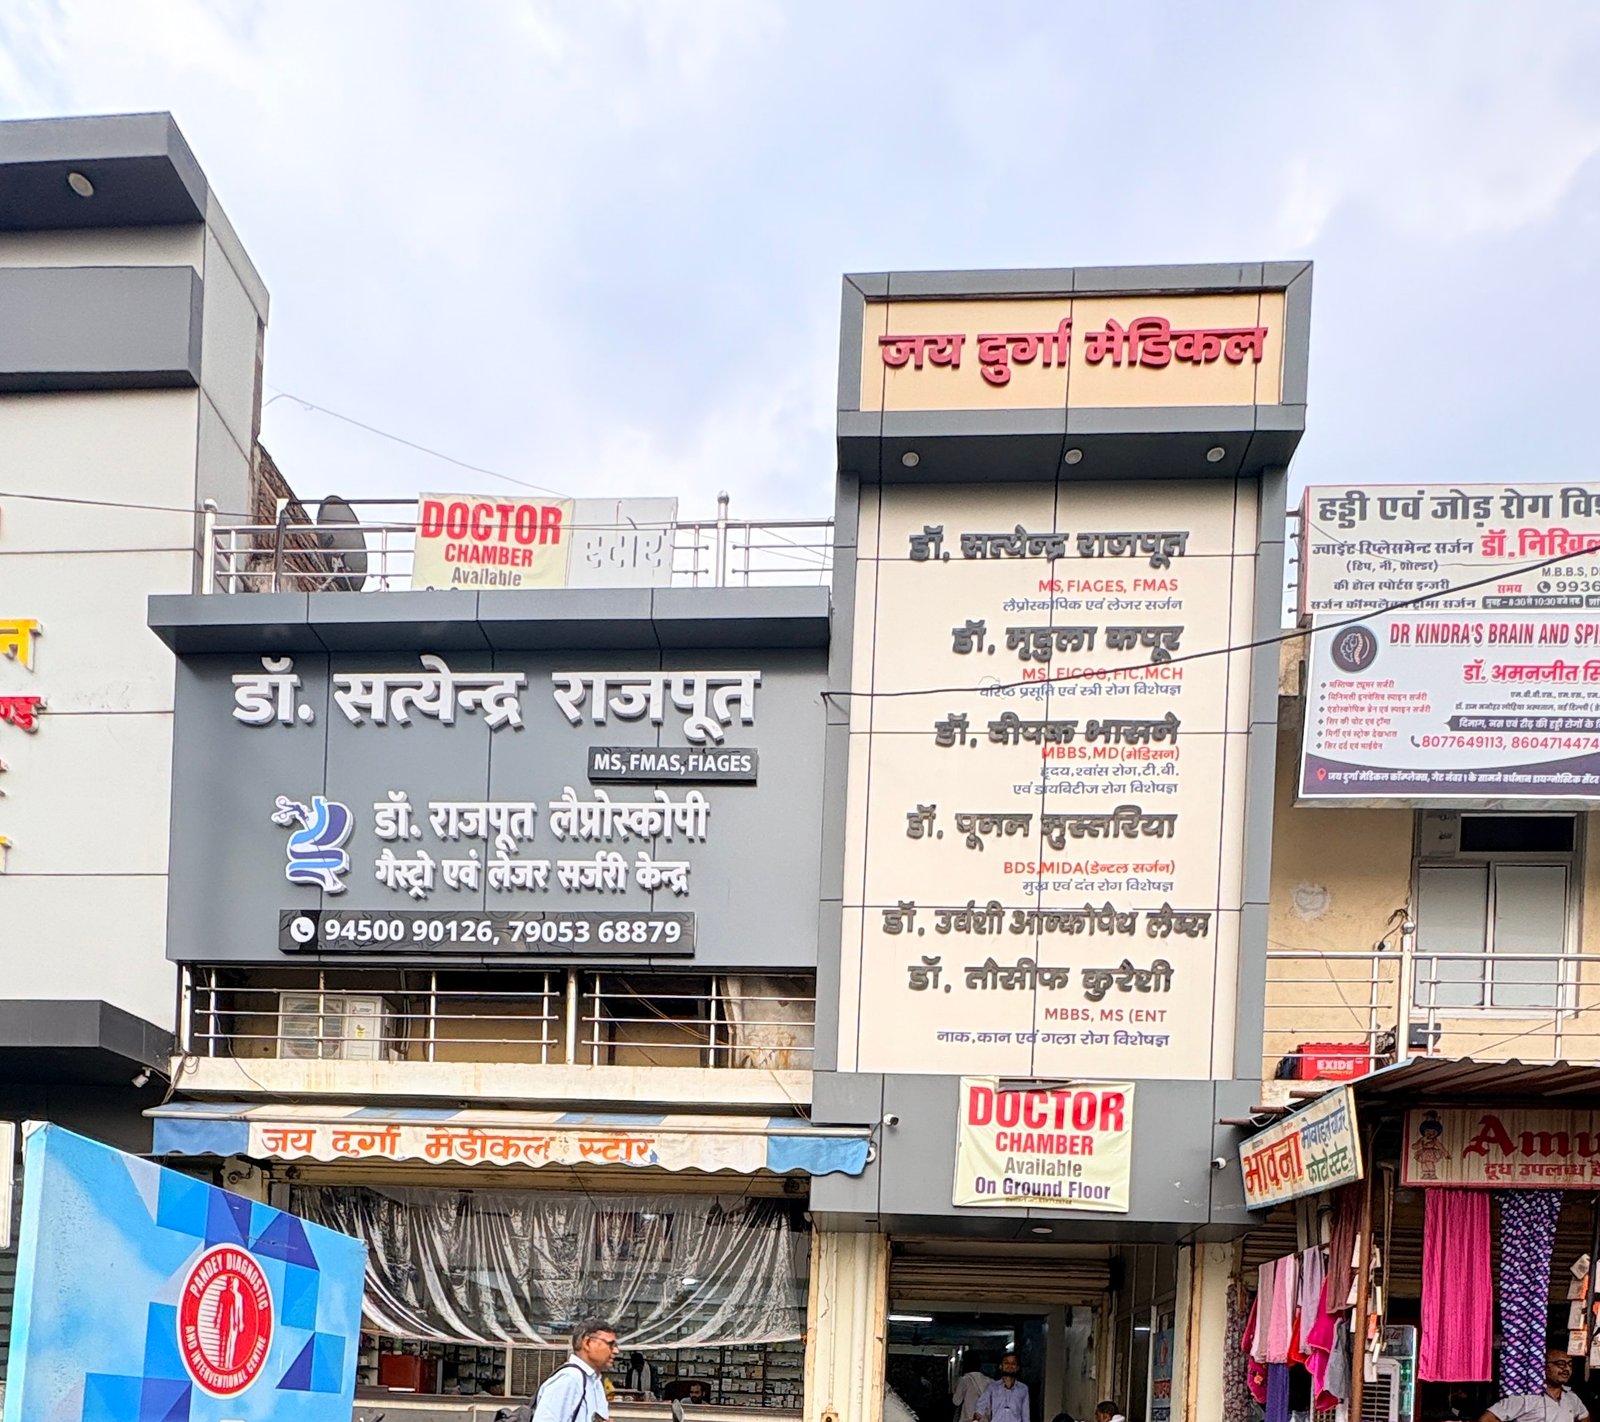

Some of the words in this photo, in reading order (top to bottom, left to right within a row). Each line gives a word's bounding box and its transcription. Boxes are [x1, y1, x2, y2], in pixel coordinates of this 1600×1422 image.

[878, 334, 966, 369] जय
[977, 317, 1072, 387] दुर्गा
[1085, 317, 1268, 367] मेडिकल
[1318, 491, 1370, 528] हड्डी
[1377, 490, 1425, 520] एवं
[1430, 489, 1494, 527] जोड़
[1499, 488, 1553, 518] रोग
[420, 500, 562, 545] DOCTOR
[444, 543, 533, 568] CHAMBER
[909, 525, 950, 562] डॉ.
[960, 524, 1069, 563] सत्येन्द्र
[1077, 531, 1189, 569] राजपूत
[1434, 538, 1474, 554] सर्जन
[452, 567, 522, 586] Available
[1134, 579, 1178, 591] FMAS
[1085, 599, 1106, 610] एवं
[1108, 597, 1142, 611] लेजर
[1144, 596, 1182, 610] सर्जन
[952, 619, 995, 655] डॉ.
[1105, 626, 1184, 663] कपूर
[1390, 623, 1410, 644] DR
[1415, 623, 1483, 644] KINDRA'S
[1488, 624, 1534, 644] BRAIN
[1538, 624, 1569, 644] AND
[1574, 624, 1600, 644] SPI
[1464, 659, 1486, 681] डॉ.
[1491, 660, 1579, 681] अमनजीत
[231, 655, 314, 726] डॉ.
[334, 653, 527, 731] सत्येन्द्र
[552, 670, 761, 743] राजपूत
[1058, 684, 1078, 696] एवं
[1106, 683, 1129, 695] रोग
[1134, 682, 1181, 695] विशेषज्ञ
[934, 713, 977, 748] डॉ.
[1014, 782, 1034, 794] एवं
[1102, 781, 1126, 794] रोग
[1130, 780, 1177, 794] विशेषज्ञ
[373, 791, 421, 841] डॉ.
[428, 800, 537, 853] राजपूत
[548, 786, 709, 843] लैप्रोस्कोपी
[907, 805, 943, 839] डॉ.
[374, 850, 434, 898] गैस्ट्रो
[442, 849, 479, 889] एवं
[486, 850, 551, 892] लेजर
[557, 850, 628, 893] सर्जरी
[635, 853, 690, 896] केन्द्र
[1053, 878, 1073, 891] एवं
[1075, 878, 1094, 891] दंत
[1098, 878, 1121, 890] रोग
[1127, 877, 1173, 892] विशेषज्ञ
[882, 900, 924, 936] डॉ.
[935, 900, 1005, 935] उर्वशी
[325, 920, 403, 942] 94500
[412, 920, 499, 945] 90126,
[508, 920, 590, 942] 79053
[598, 920, 681, 942] 68879
[908, 956, 951, 993] डॉ.
[1045, 1008, 1094, 1021] MBBS,
[1100, 1009, 1123, 1021] MS
[1128, 1009, 1167, 1024] (ENT
[1016, 1029, 1040, 1044] एवं
[1041, 1033, 1076, 1045] गला
[1081, 1030, 1108, 1045] रोग
[1113, 1030, 1169, 1047] विशेषज्ञ
[1317, 1060, 1353, 1070] EXIDE
[969, 1086, 1125, 1132] DOCTOR
[262, 1128, 316, 1153] जय
[332, 1125, 402, 1157] दुर्गा
[996, 1132, 1093, 1156] CHAMBER
[1004, 1157, 1082, 1177] Available
[1243, 1131, 1304, 1195] भावना
[975, 1177, 996, 1194] On
[1003, 1178, 1062, 1197] Ground
[1069, 1181, 1110, 1199] Floor
[226, 1253, 268, 1310] DIAGNOSTIC
[185, 1326, 195, 1348] AND
